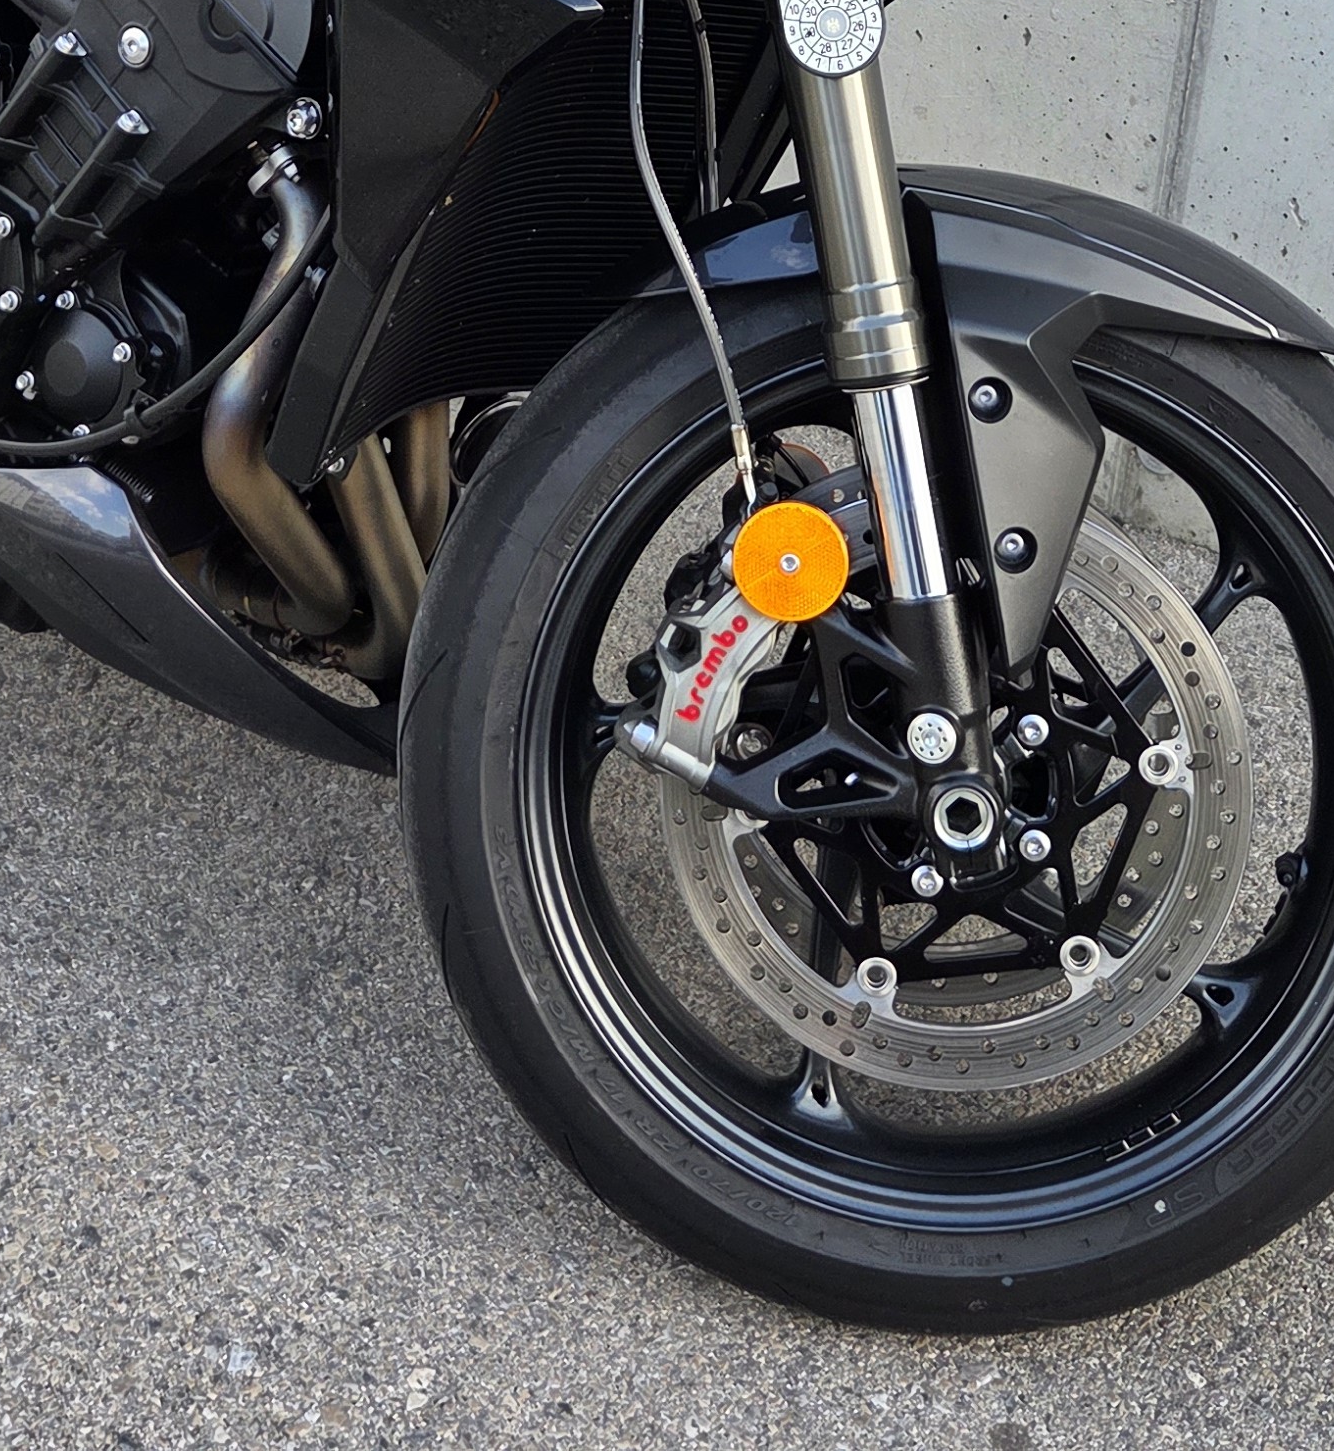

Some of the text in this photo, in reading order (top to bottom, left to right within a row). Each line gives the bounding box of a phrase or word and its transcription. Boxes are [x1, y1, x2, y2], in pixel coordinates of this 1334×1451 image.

[789, 4, 800, 15] 10
[844, 0, 857, 11] 25
[804, 6, 817, 18] 30
[852, 20, 864, 32] 26
[819, 42, 832, 54] 28
[841, 38, 853, 50] 27
[675, 614, 748, 722] brembo
[594, 1070, 629, 1107] 17
[633, 1112, 680, 1157] ZR
[688, 1160, 798, 1228] 120/70
[1139, 1180, 1207, 1230] SP
